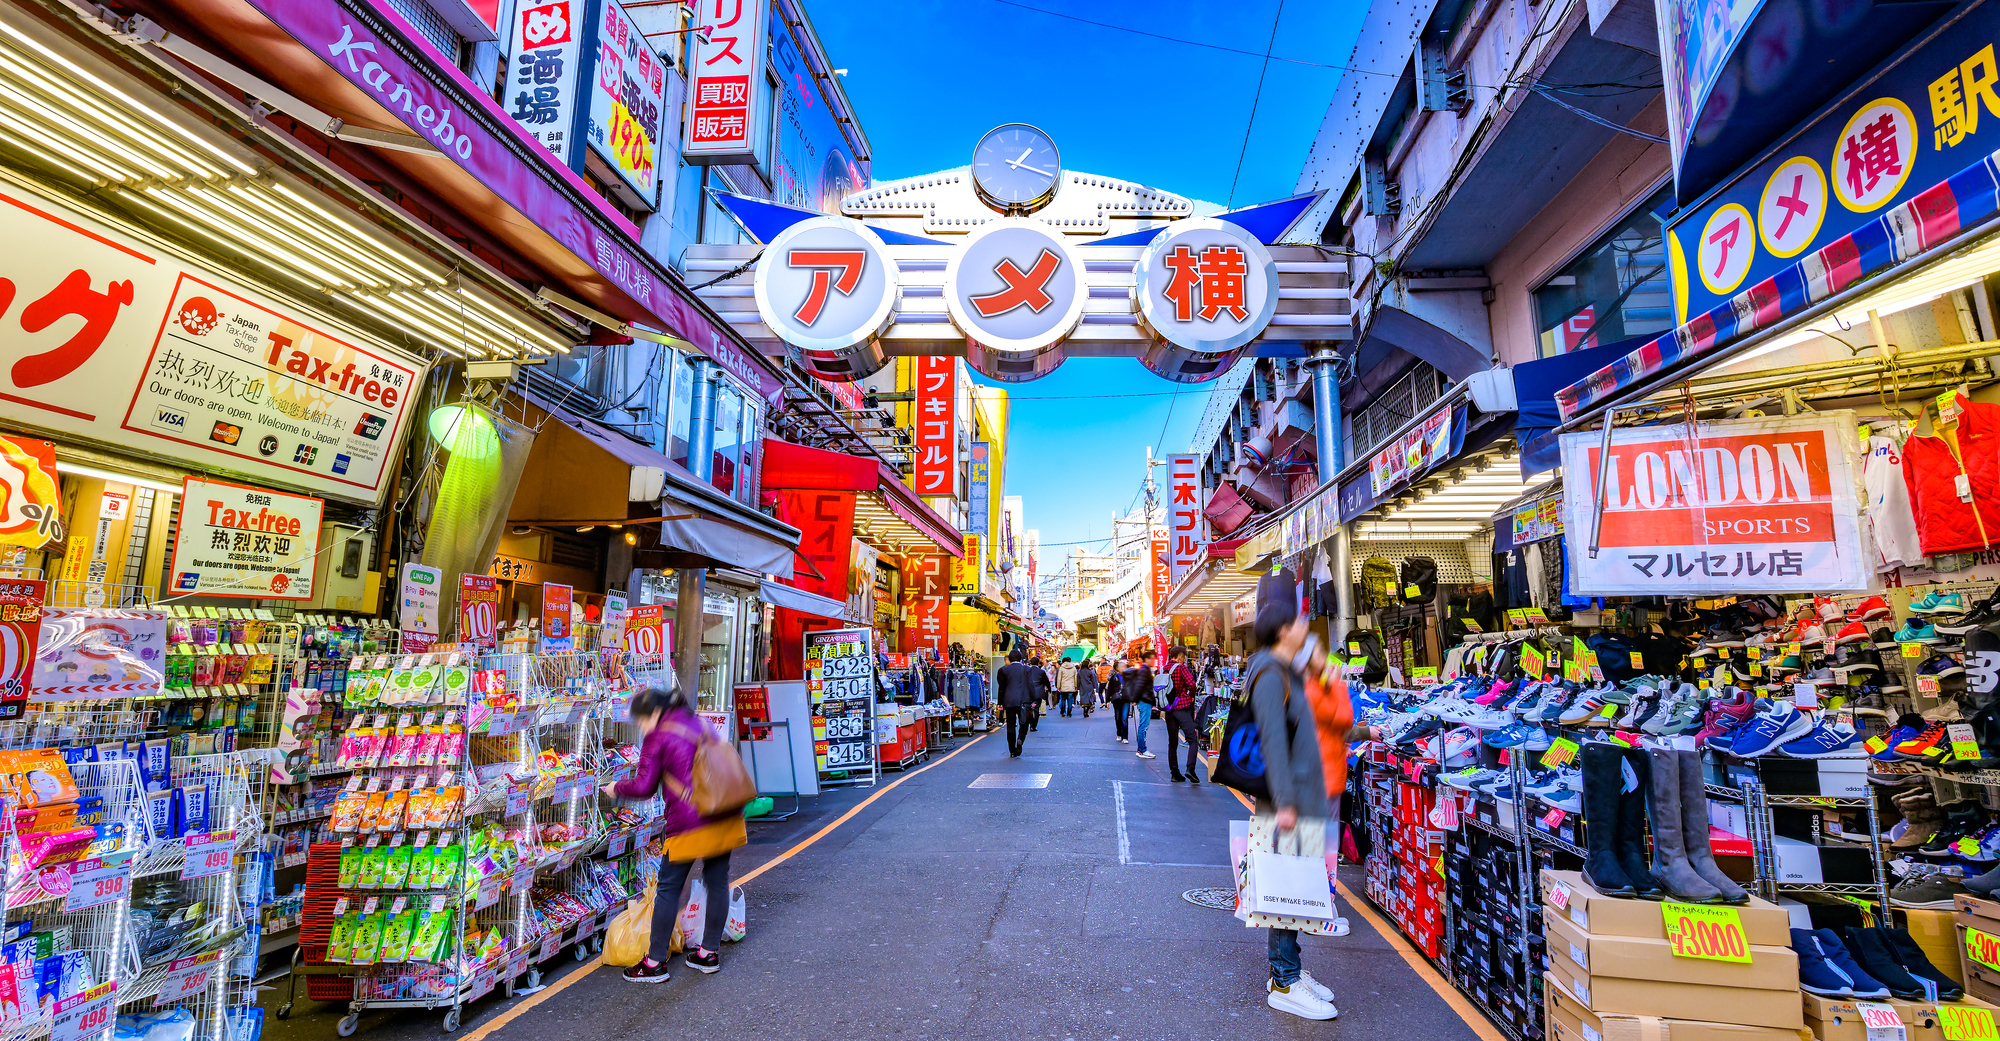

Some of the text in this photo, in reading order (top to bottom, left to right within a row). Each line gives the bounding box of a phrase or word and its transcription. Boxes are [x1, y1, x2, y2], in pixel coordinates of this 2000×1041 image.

[328, 22, 474, 161] Kanebo
[698, 83, 746, 104] 買取
[695, 116, 744, 138] 販売
[594, 236, 652, 304] 雪肌精
[224, 323, 259, 344] Tax-free
[231, 313, 261, 333] Japan.
[233, 339, 255, 354] Shop
[709, 328, 761, 389] Tax-free
[155, 349, 265, 405] 热烈欢迎
[267, 331, 398, 408] Tax-free
[370, 363, 404, 388] 免税店
[149, 381, 341, 446] Our doors are open. Welcome to Japan!
[158, 410, 185, 427] VISA
[213, 426, 239, 440] MasterCard
[294, 446, 316, 463] JCB
[1605, 441, 1809, 512] LONDON
[245, 493, 272, 506] 免税店
[207, 500, 301, 535] Tax-free
[1173, 459, 1199, 566] 二木ゴル
[1701, 517, 1811, 536] SPORTS
[211, 529, 290, 556] 热烈欢迎
[967, 537, 977, 566] 御徒町
[193, 559, 204, 567] Our
[204, 560, 222, 569] doors
[223, 562, 233, 570] are
[234, 563, 249, 571] open.
[250, 564, 276, 572] Welcome
[1628, 549, 1802, 577] マルセル店
[959, 583, 974, 591] 入口
[815, 634, 859, 643] GINZA PARIS
[805, 656, 871, 677] K24 5923
[823, 678, 871, 699] 4504
[828, 718, 861, 736] 386
[829, 743, 864, 764] 345
[205, 852, 228, 868] 499
[94, 876, 123, 897] 398
[1281, 897, 1301, 905] MIYAKE
[1302, 899, 1326, 908] SHIBUYA
[181, 971, 207, 991] 339
[78, 1007, 108, 1031] 498
[1829, 1006, 1856, 1014] ellesse
